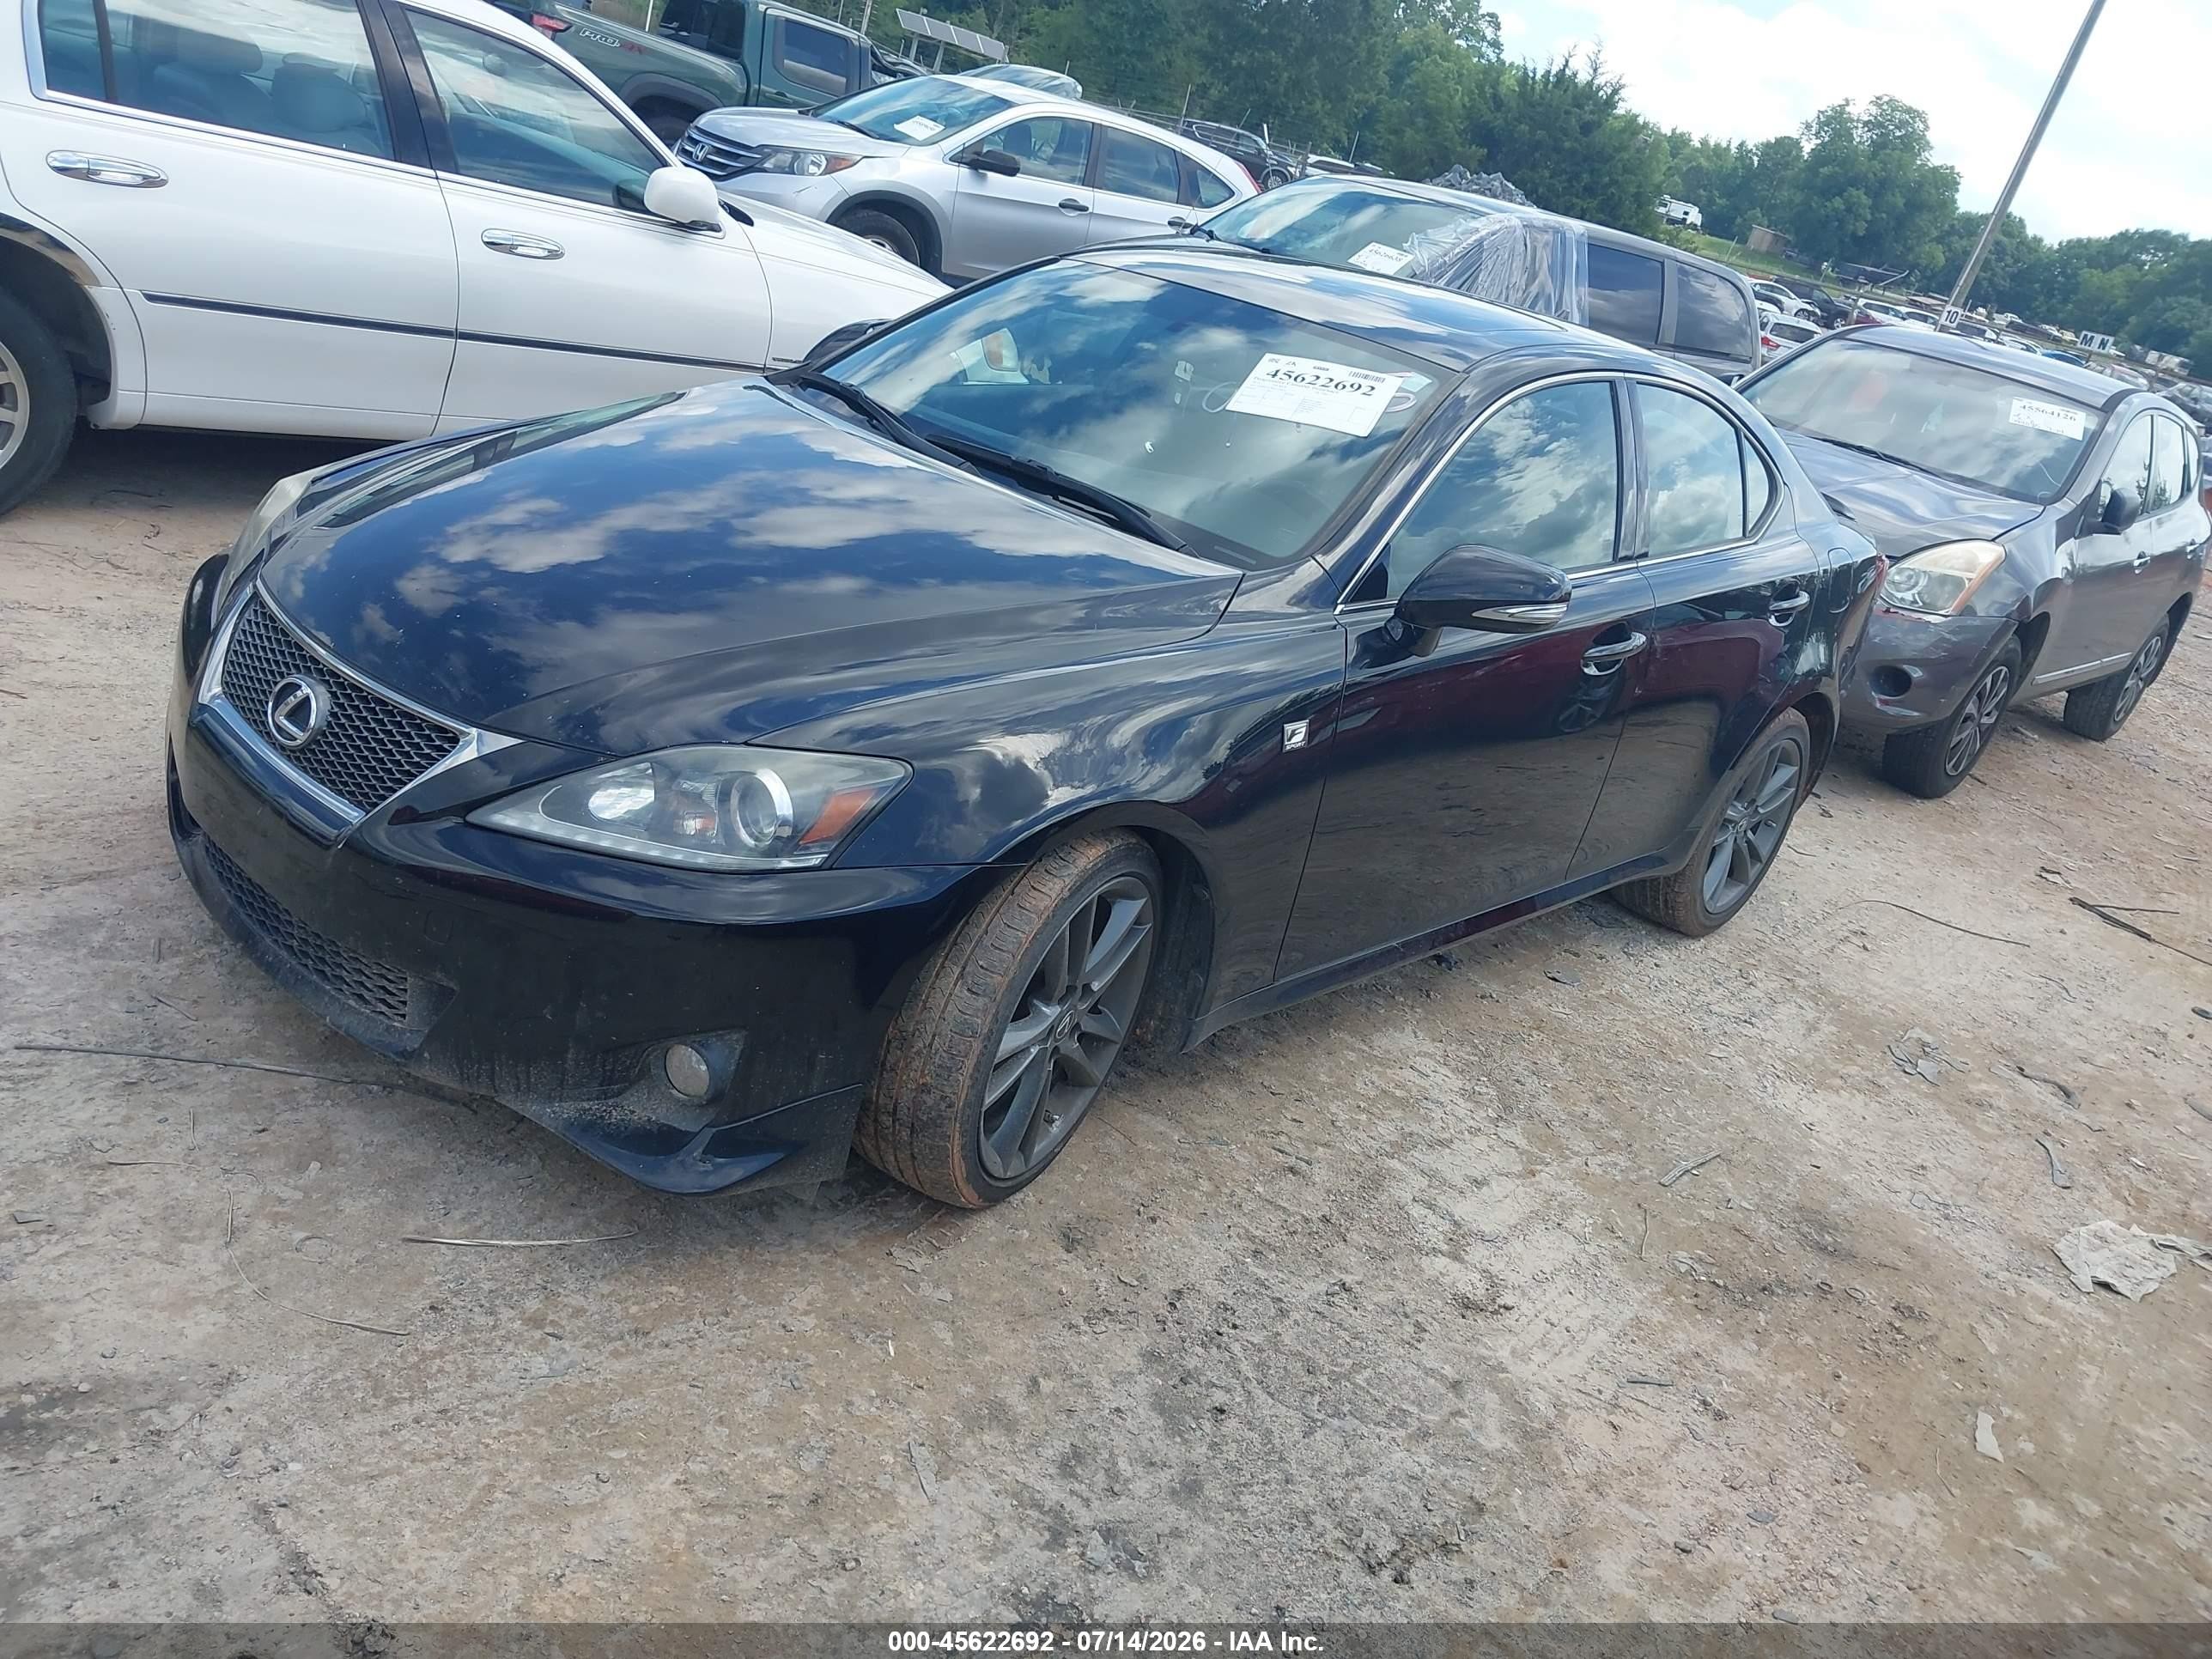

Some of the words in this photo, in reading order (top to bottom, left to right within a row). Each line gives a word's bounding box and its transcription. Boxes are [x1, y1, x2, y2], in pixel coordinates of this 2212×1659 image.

[1944, 309, 1960, 324] 10
[2080, 333, 2095, 348] M
[2097, 337, 2110, 350] N
[1266, 368, 1376, 397] 45622692
[1285, 740, 1306, 750] SPORT
